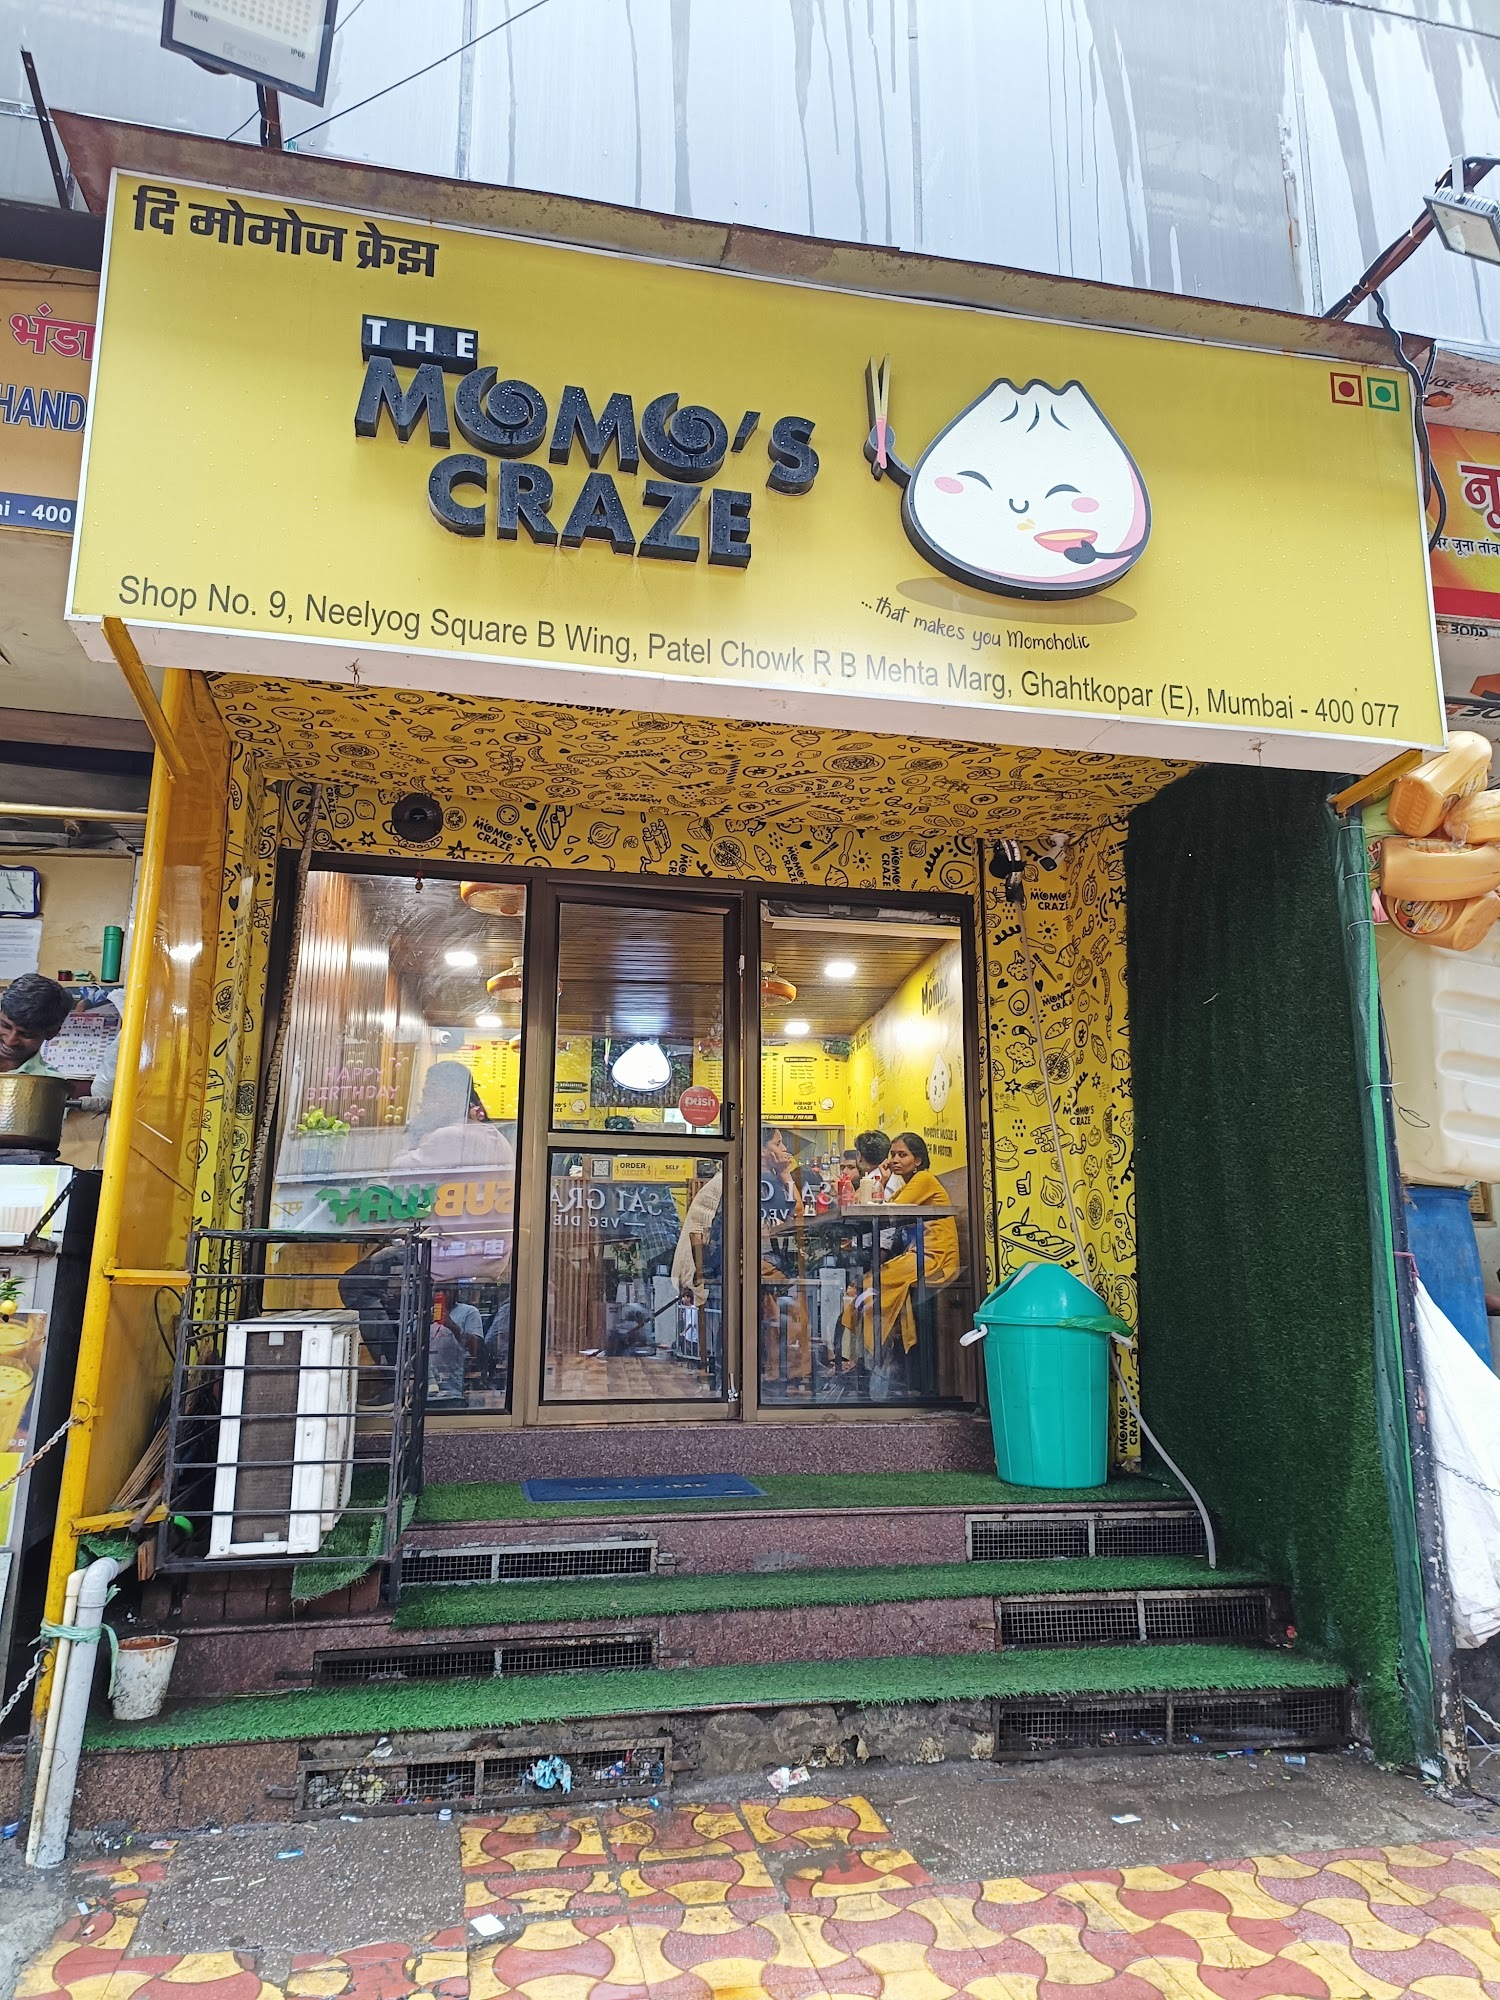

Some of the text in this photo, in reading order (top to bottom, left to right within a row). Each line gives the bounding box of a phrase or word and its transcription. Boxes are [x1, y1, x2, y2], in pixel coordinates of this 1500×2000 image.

[290, 48, 306, 60] IP66
[132, 184, 440, 278] दि मोमोज क्रेझ
[365, 317, 475, 360] THE
[355, 355, 820, 497] MOMO'S
[31, 504, 72, 524] 400
[428, 452, 753, 570] CRAZE
[914, 617, 965, 641] makes
[971, 630, 1001, 651] you
[1006, 629, 1090, 651] Momoholic
[118, 575, 197, 616] Shop
[208, 583, 256, 616] No.
[269, 590, 293, 624] 9,
[306, 594, 420, 641] Neelyog
[430, 608, 528, 645] Square
[537, 620, 556, 648] B
[565, 623, 638, 664] Wing,
[649, 632, 712, 665] Patel
[720, 640, 804, 674] Chowk
[813, 649, 832, 677] R
[840, 652, 857, 678] B
[865, 654, 939, 687] Mehta
[947, 662, 1012, 700] Marg,
[1021, 670, 1153, 711] Ghahtkopar
[1160, 683, 1199, 717] (E),
[1207, 688, 1294, 720] Mumbai
[1314, 698, 1354, 724] 400
[1361, 701, 1399, 728] 077
[472, 820, 524, 847] MOMO'S
[476, 832, 513, 852] CRAZE
[781, 855, 798, 884] CRAZE
[881, 853, 892, 887] CRAZE
[1038, 900, 1069, 911] CRAZE
[325, 1066, 386, 1082] HAPPY
[307, 1085, 401, 1101] BIRTHDAY
[684, 1096, 716, 1107] push
[1069, 1116, 1091, 1126] CRAZE
[1118, 1395, 1128, 1455] MOMO'S
